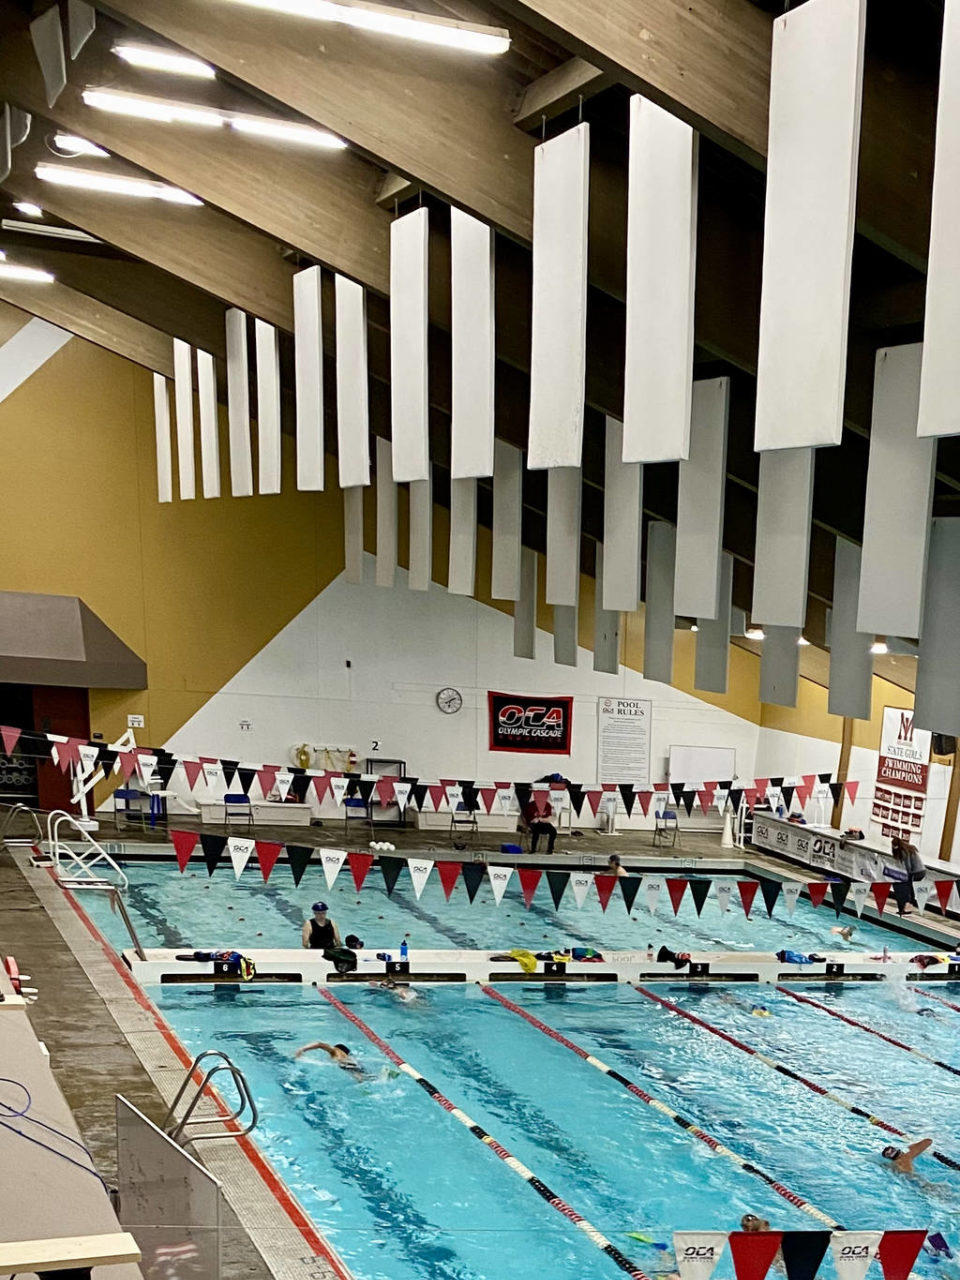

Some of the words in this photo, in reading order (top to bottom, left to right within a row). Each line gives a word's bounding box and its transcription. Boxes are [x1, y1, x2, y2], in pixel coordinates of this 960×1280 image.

[617, 701, 641, 709] POOL
[617, 708, 645, 716] RULES
[498, 705, 564, 730] OCA
[498, 727, 530, 736] OLYMPIC
[372, 741, 379, 751] 2
[887, 745, 904, 758] STATE
[904, 748, 923, 760] GIRLS
[884, 758, 922, 774] SWIMMING
[881, 767, 923, 785] CHAMPIONS
[813, 839, 835, 858] OCA
[395, 963, 400, 971] 5
[551, 962, 557, 971] 4
[832, 963, 838, 972] 2
[955, 963, 959, 972] 1
[685, 1247, 714, 1256] OCA
[841, 1246, 869, 1255] OCA
